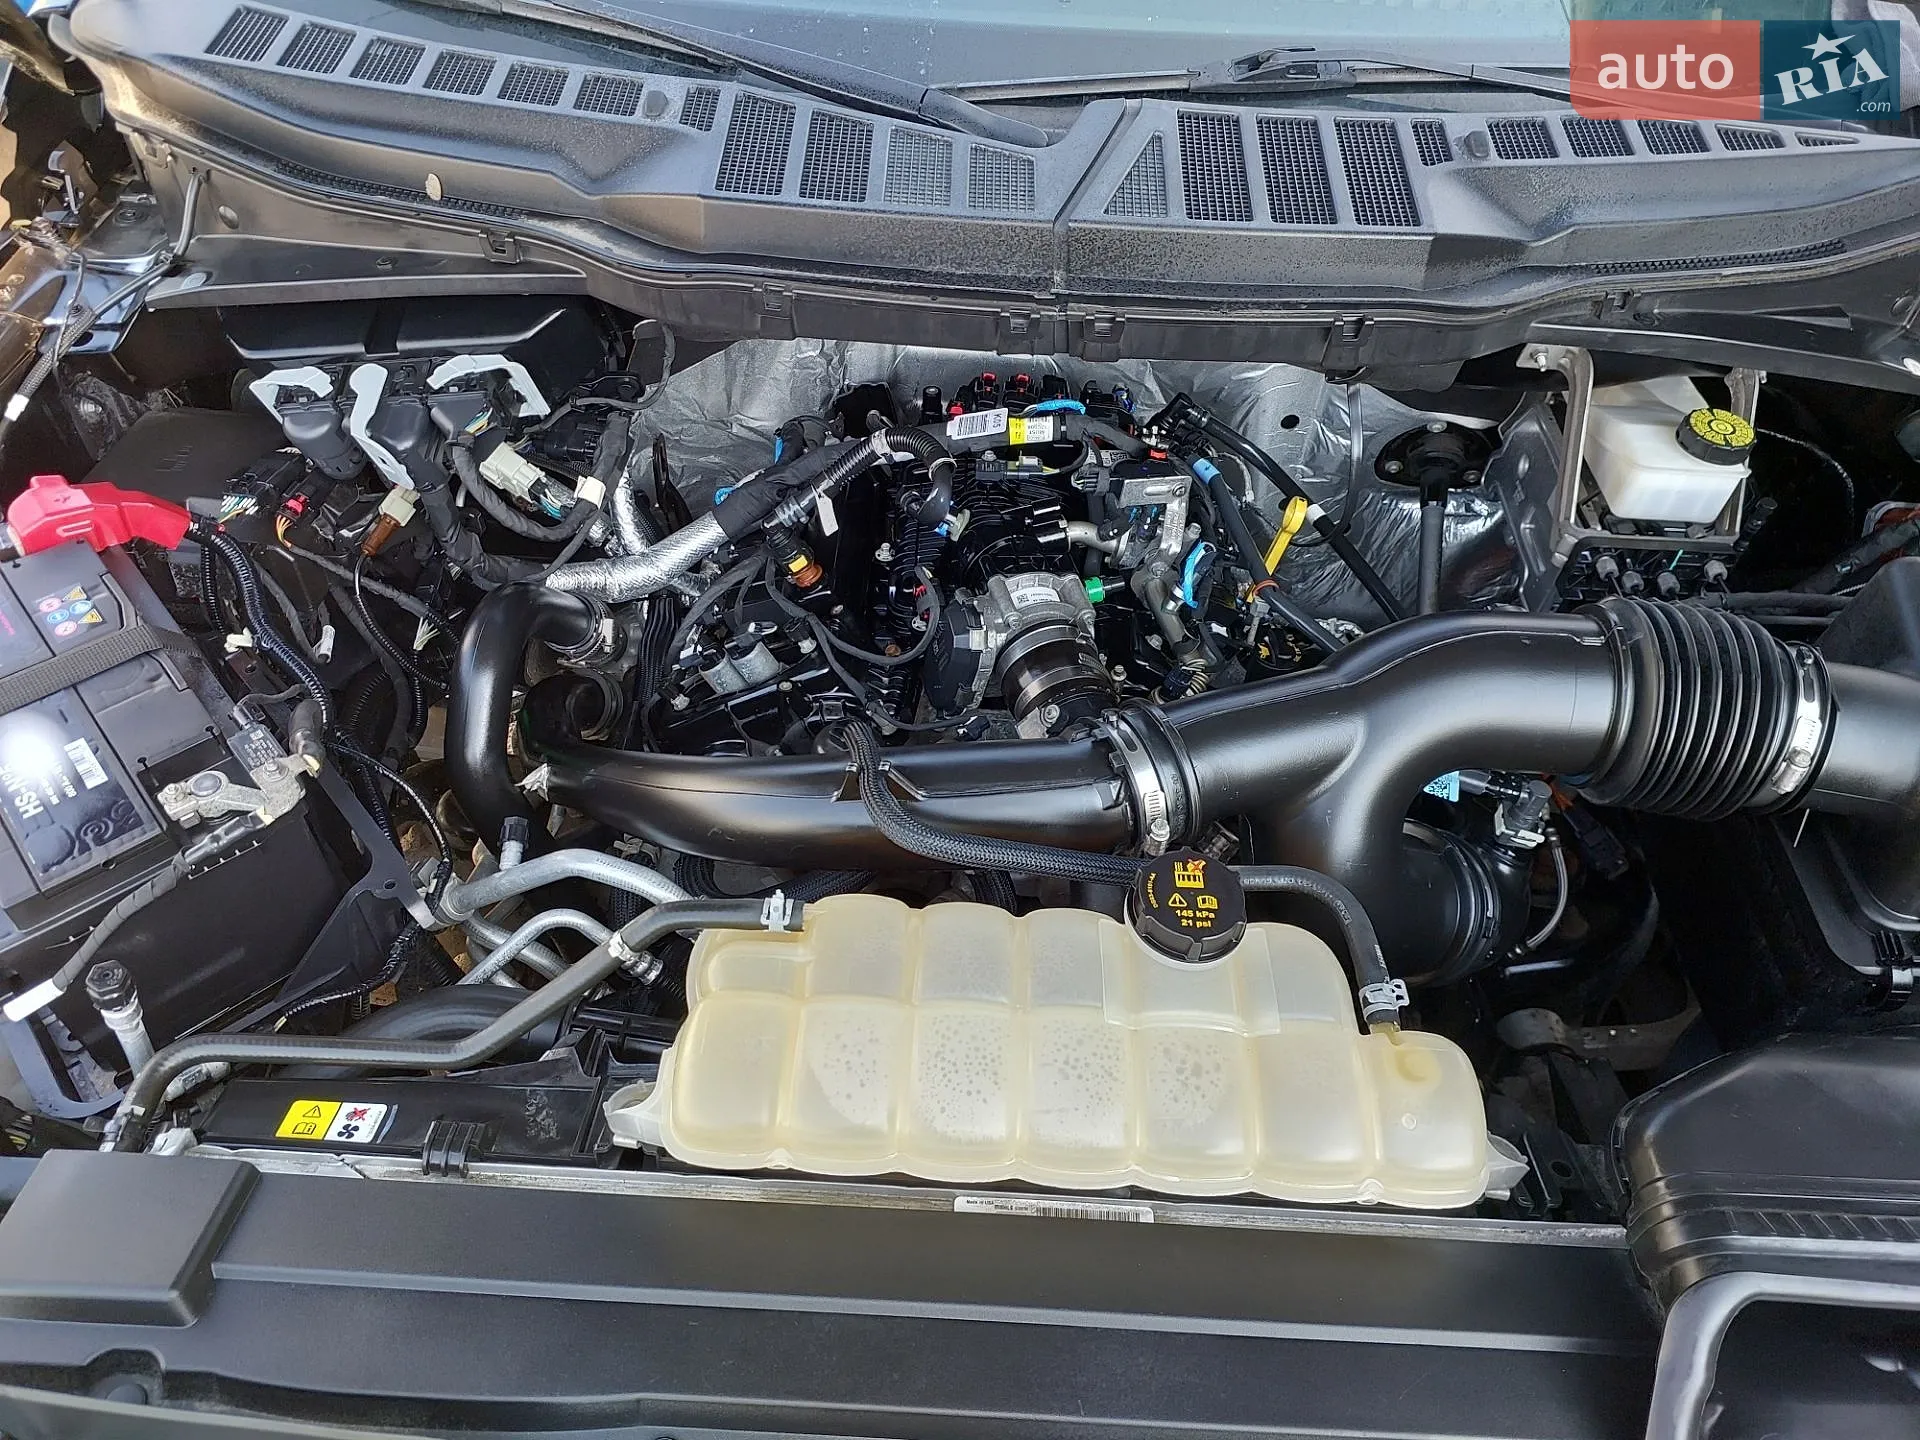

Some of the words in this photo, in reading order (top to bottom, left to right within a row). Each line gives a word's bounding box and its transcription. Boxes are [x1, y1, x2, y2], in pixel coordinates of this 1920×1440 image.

[1175, 909, 1193, 918] 145
[1196, 910, 1215, 919] kPa
[1181, 919, 1193, 927] 21
[1196, 919, 1212, 928] psi
